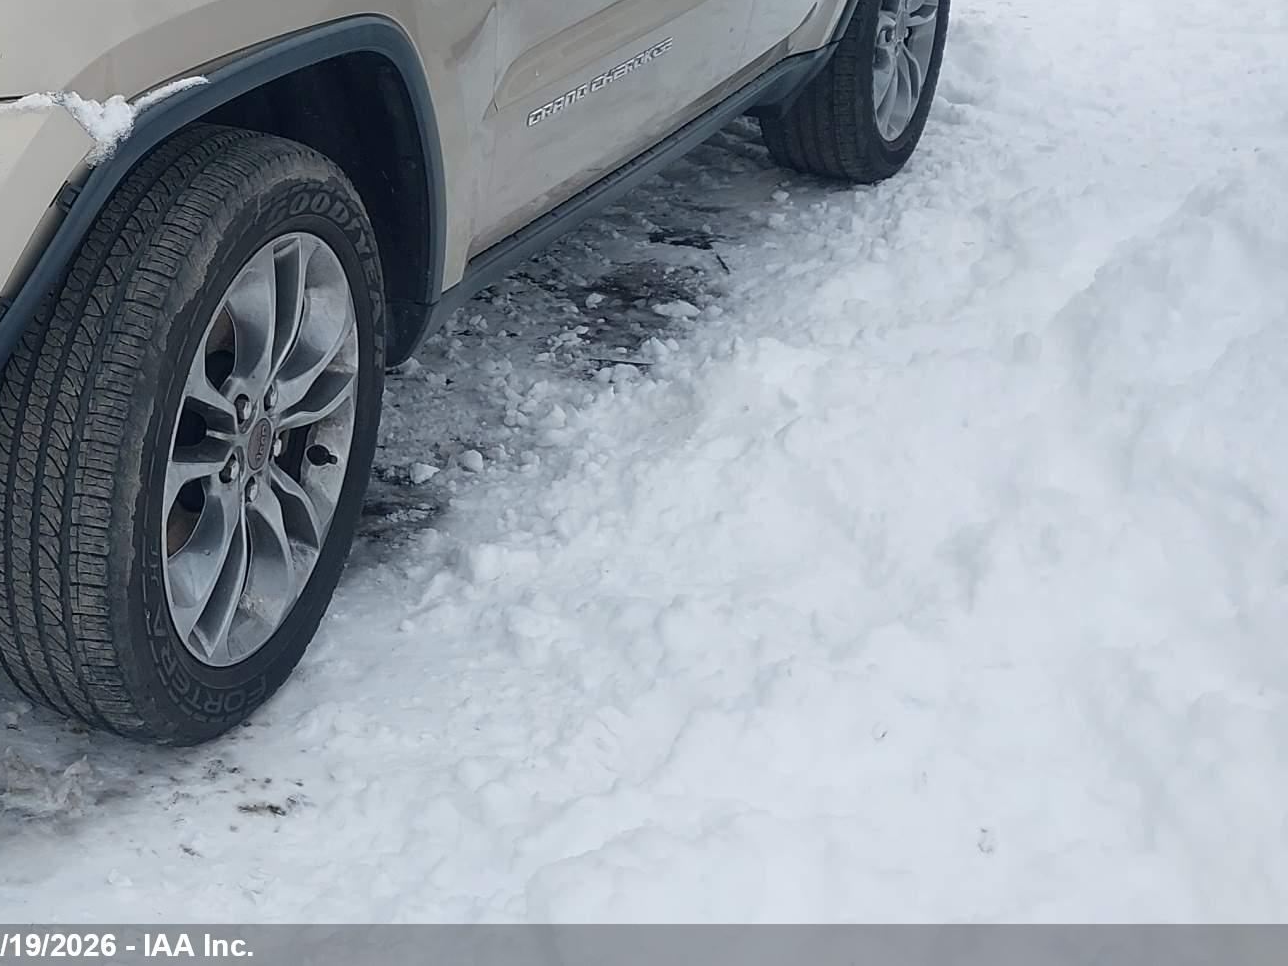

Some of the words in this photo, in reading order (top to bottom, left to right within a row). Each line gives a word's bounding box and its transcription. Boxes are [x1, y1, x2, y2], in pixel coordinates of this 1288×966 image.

[527, 83, 588, 127] GRAND
[589, 36, 673, 93] CHEROKEE
[265, 191, 386, 370] GOODYEAR
